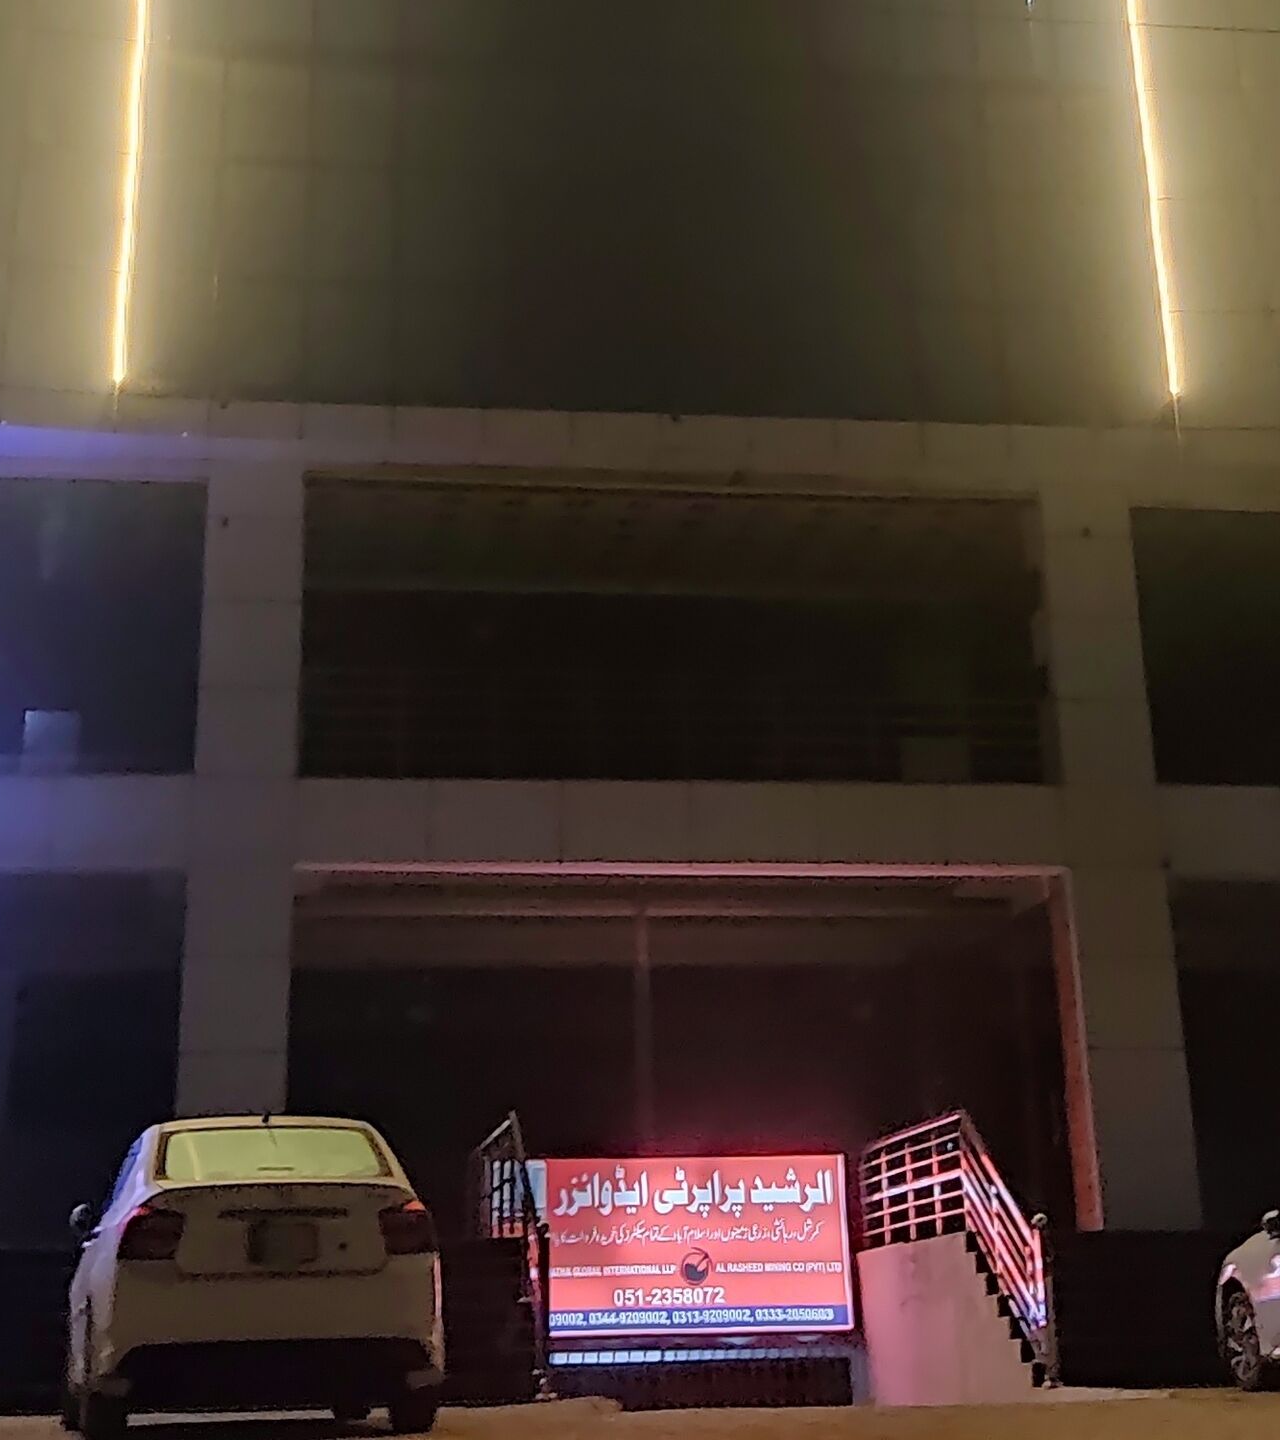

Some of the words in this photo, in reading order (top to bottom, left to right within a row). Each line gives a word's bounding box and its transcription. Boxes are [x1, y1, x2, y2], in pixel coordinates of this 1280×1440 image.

[653, 1165, 745, 1218] پراپرٹی
[750, 1167, 833, 1212] الرشید
[715, 1262, 726, 1273] AL
[727, 1262, 764, 1273] RASHEED
[792, 1262, 805, 1272] CO
[826, 1262, 842, 1273] LTD
[613, 1287, 725, 1305] 051-2358072
